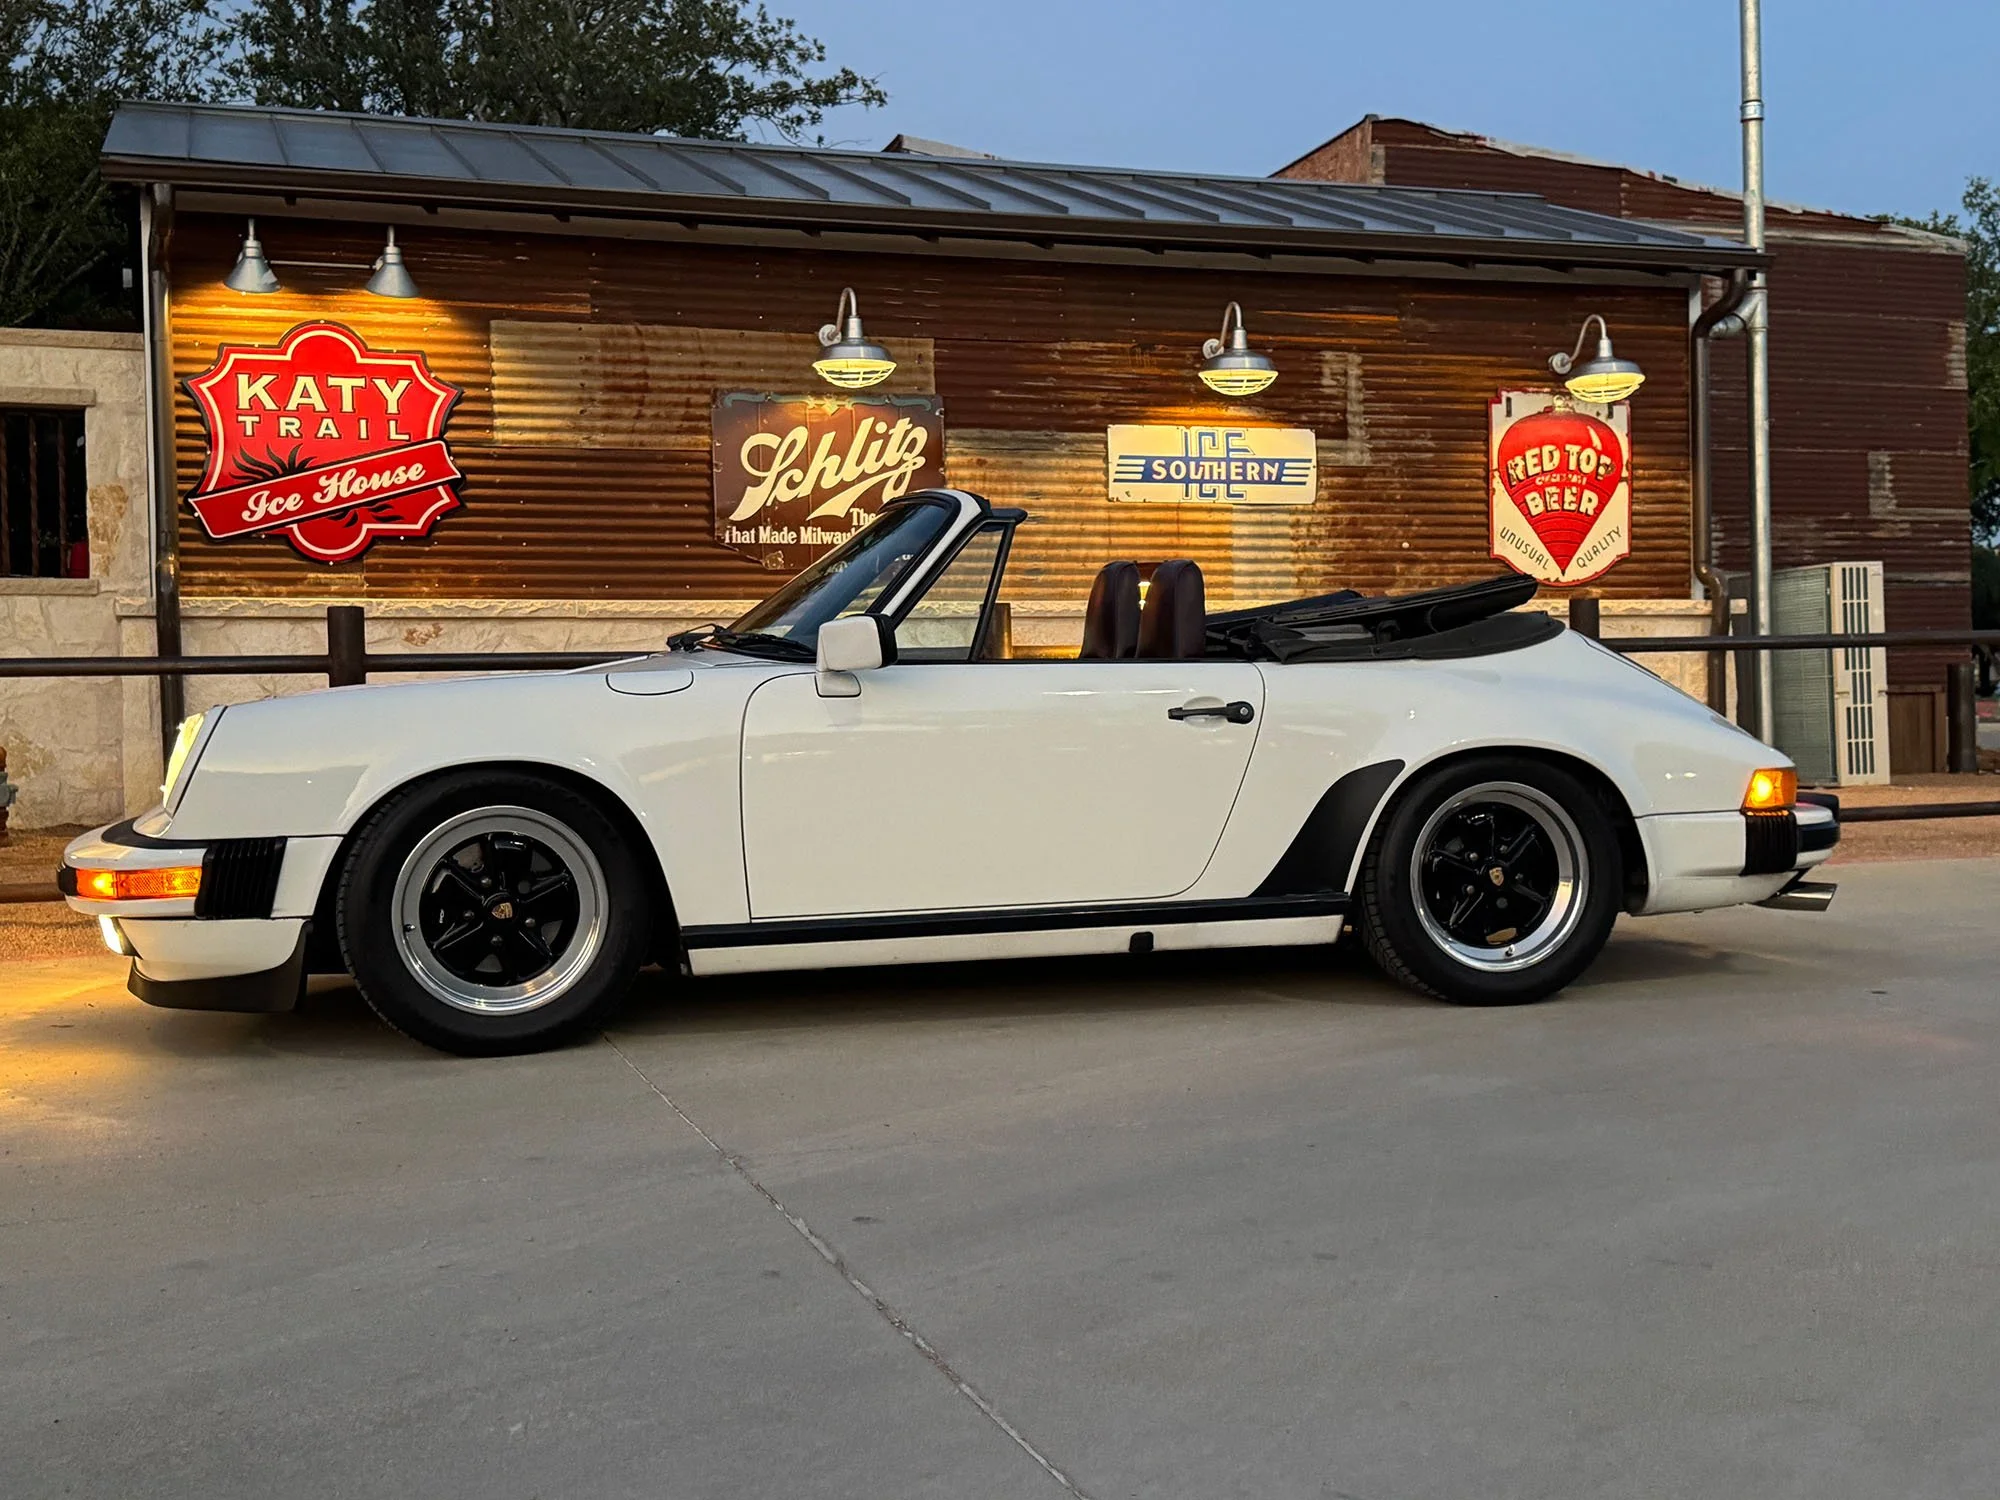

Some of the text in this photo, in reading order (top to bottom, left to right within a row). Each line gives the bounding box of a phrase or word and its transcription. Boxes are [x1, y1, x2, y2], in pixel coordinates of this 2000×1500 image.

[236, 372, 413, 415] KATY
[237, 415, 410, 441] TRAIL
[729, 417, 928, 521] Schlitz
[1151, 459, 1280, 482] SOUTHERN
[1506, 445, 1561, 486] RED
[241, 462, 426, 522] Ice House
[1525, 486, 1599, 516] BEER
[758, 525, 797, 544] Made
[1500, 526, 1549, 570] UNUSUAL
[1576, 526, 1623, 568] QUALITY
